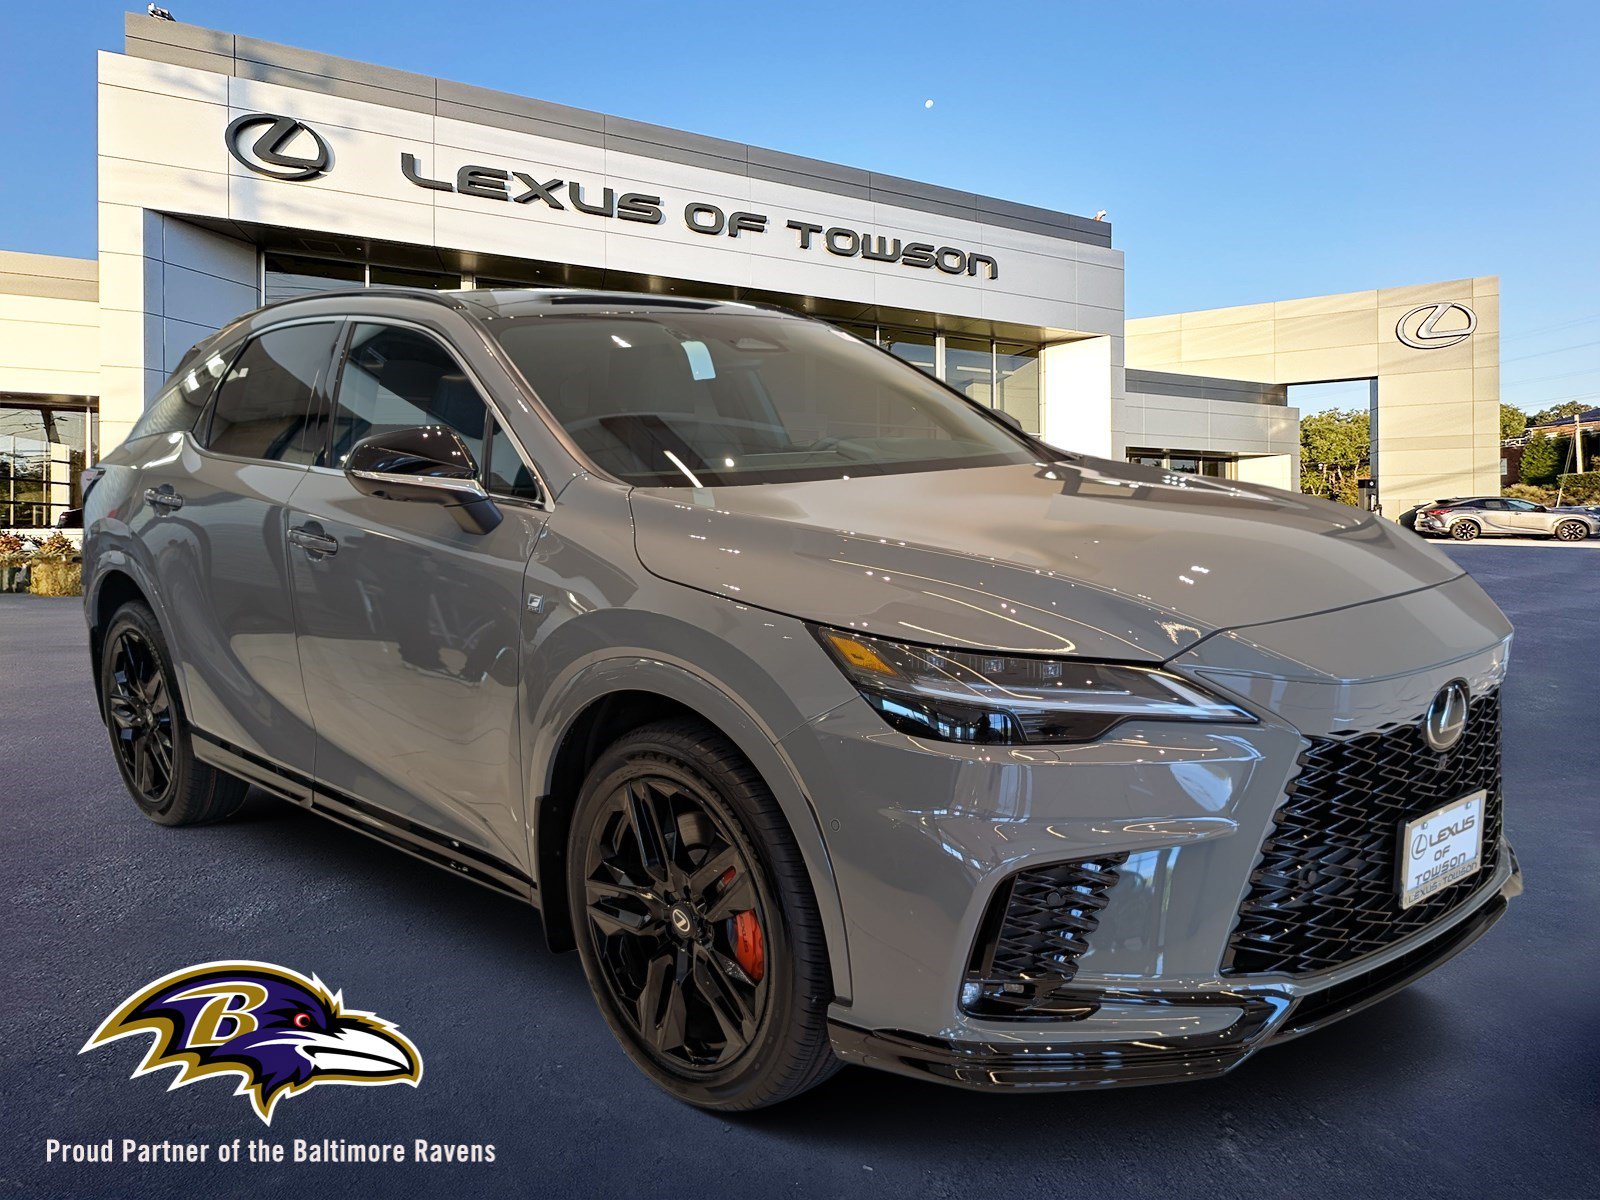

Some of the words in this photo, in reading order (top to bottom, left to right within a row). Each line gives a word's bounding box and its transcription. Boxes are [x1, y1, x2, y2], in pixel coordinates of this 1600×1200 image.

[401, 152, 663, 225] LEXUS
[684, 202, 768, 237] OF
[787, 219, 999, 280] TOWSON
[1429, 815, 1475, 847] LEXUS
[1414, 852, 1466, 887] TOWSON
[1434, 844, 1451, 862] OF
[1408, 881, 1438, 903] LEXUS
[1443, 861, 1478, 884] TOWSON
